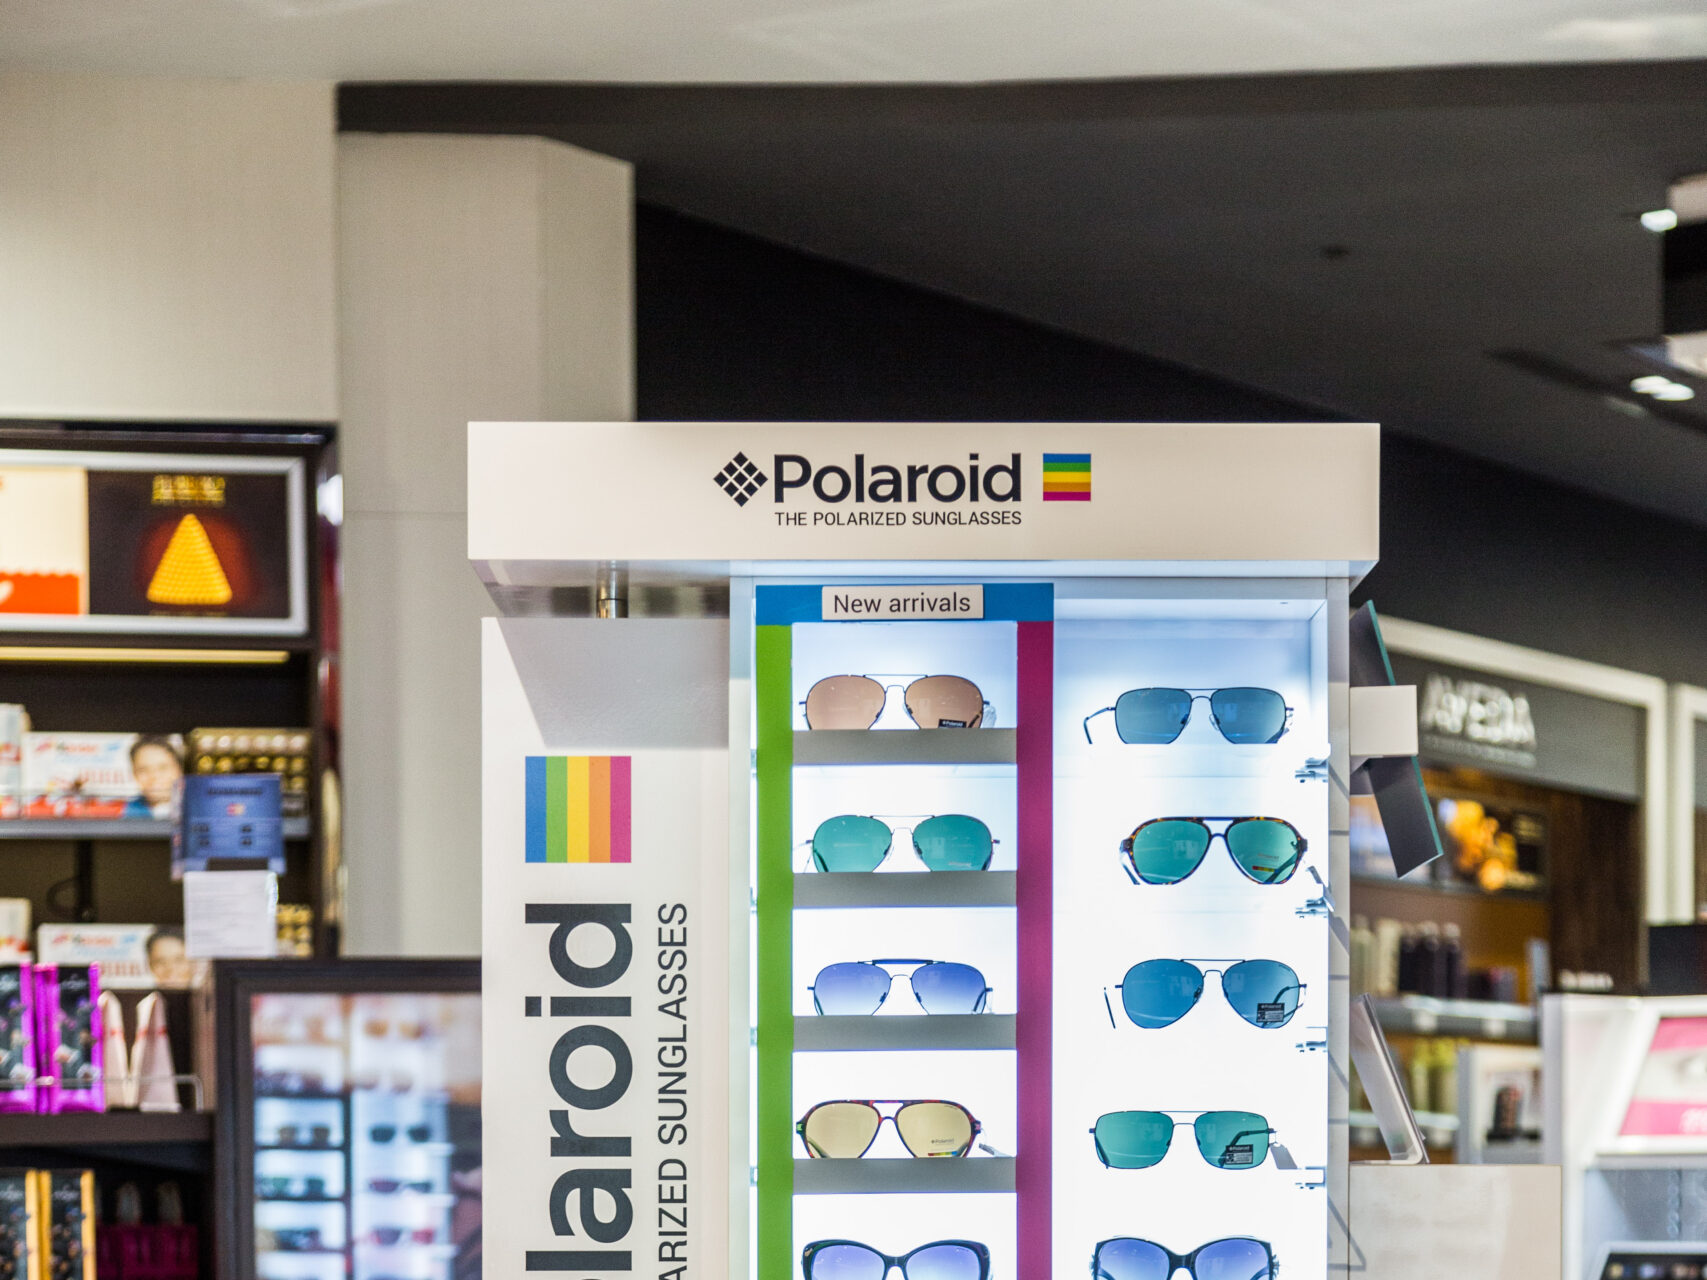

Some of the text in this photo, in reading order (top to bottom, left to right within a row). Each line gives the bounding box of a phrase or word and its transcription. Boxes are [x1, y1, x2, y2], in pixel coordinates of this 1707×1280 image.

[774, 452, 1022, 504] Polaroid
[774, 510, 1023, 527] THE POLARIZED SUNGLASSES
[834, 591, 971, 614] New arrivals
[657, 902, 689, 1146] SUNGLASSES
